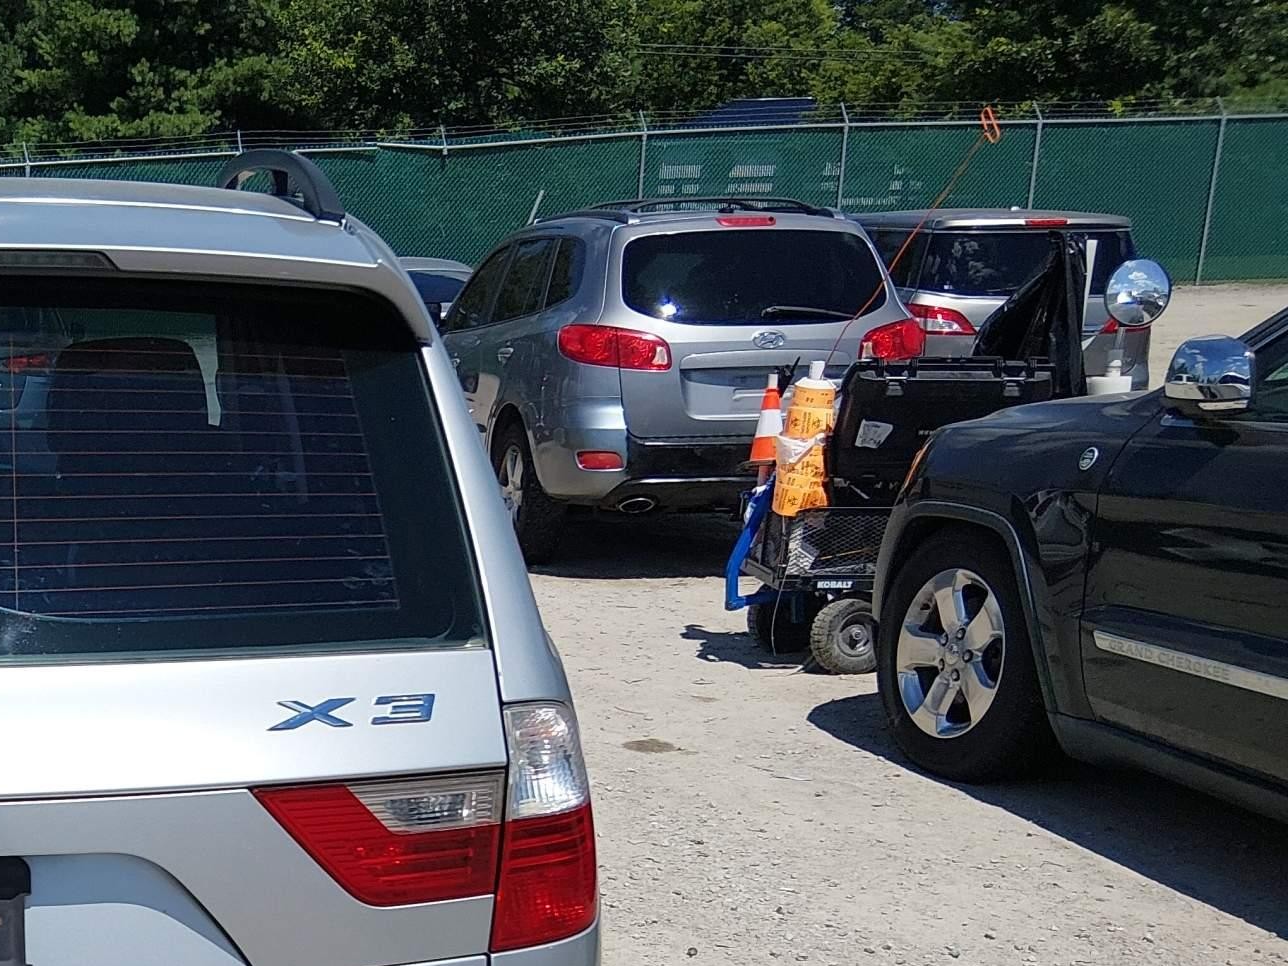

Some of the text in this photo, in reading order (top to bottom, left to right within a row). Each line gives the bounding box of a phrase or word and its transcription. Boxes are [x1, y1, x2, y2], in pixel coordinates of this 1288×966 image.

[817, 581, 853, 589] KOBALT
[1108, 638, 1231, 681] GRAND CHEROKEE
